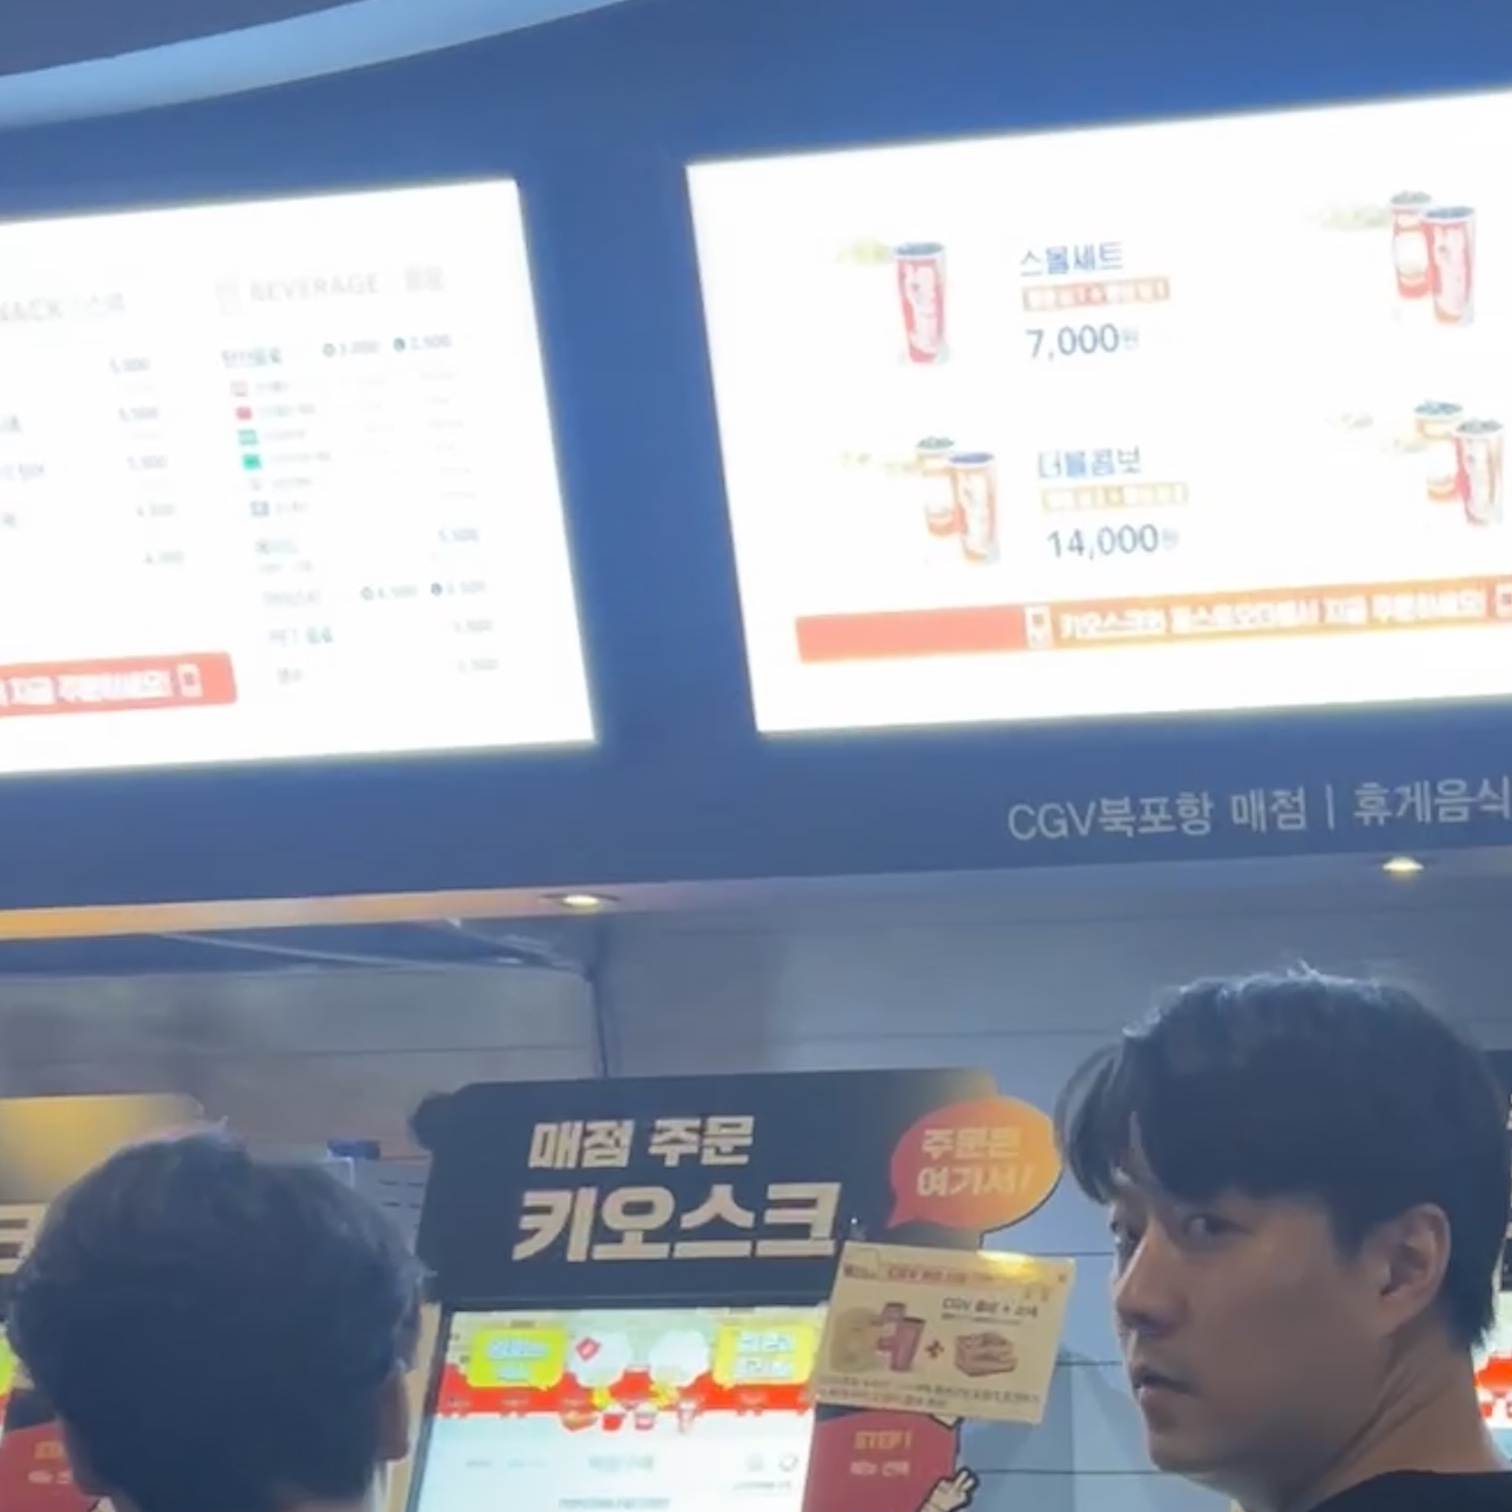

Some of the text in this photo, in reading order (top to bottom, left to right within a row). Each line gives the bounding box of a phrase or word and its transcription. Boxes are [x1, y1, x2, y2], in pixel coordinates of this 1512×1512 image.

[1008, 789, 1214, 841] CGV북포항
[1231, 784, 1308, 834] 매점
[527, 1114, 756, 1172] 매점 주문
[916, 1164, 1034, 1200] 여기서!
[511, 1181, 843, 1264] 키오스크
